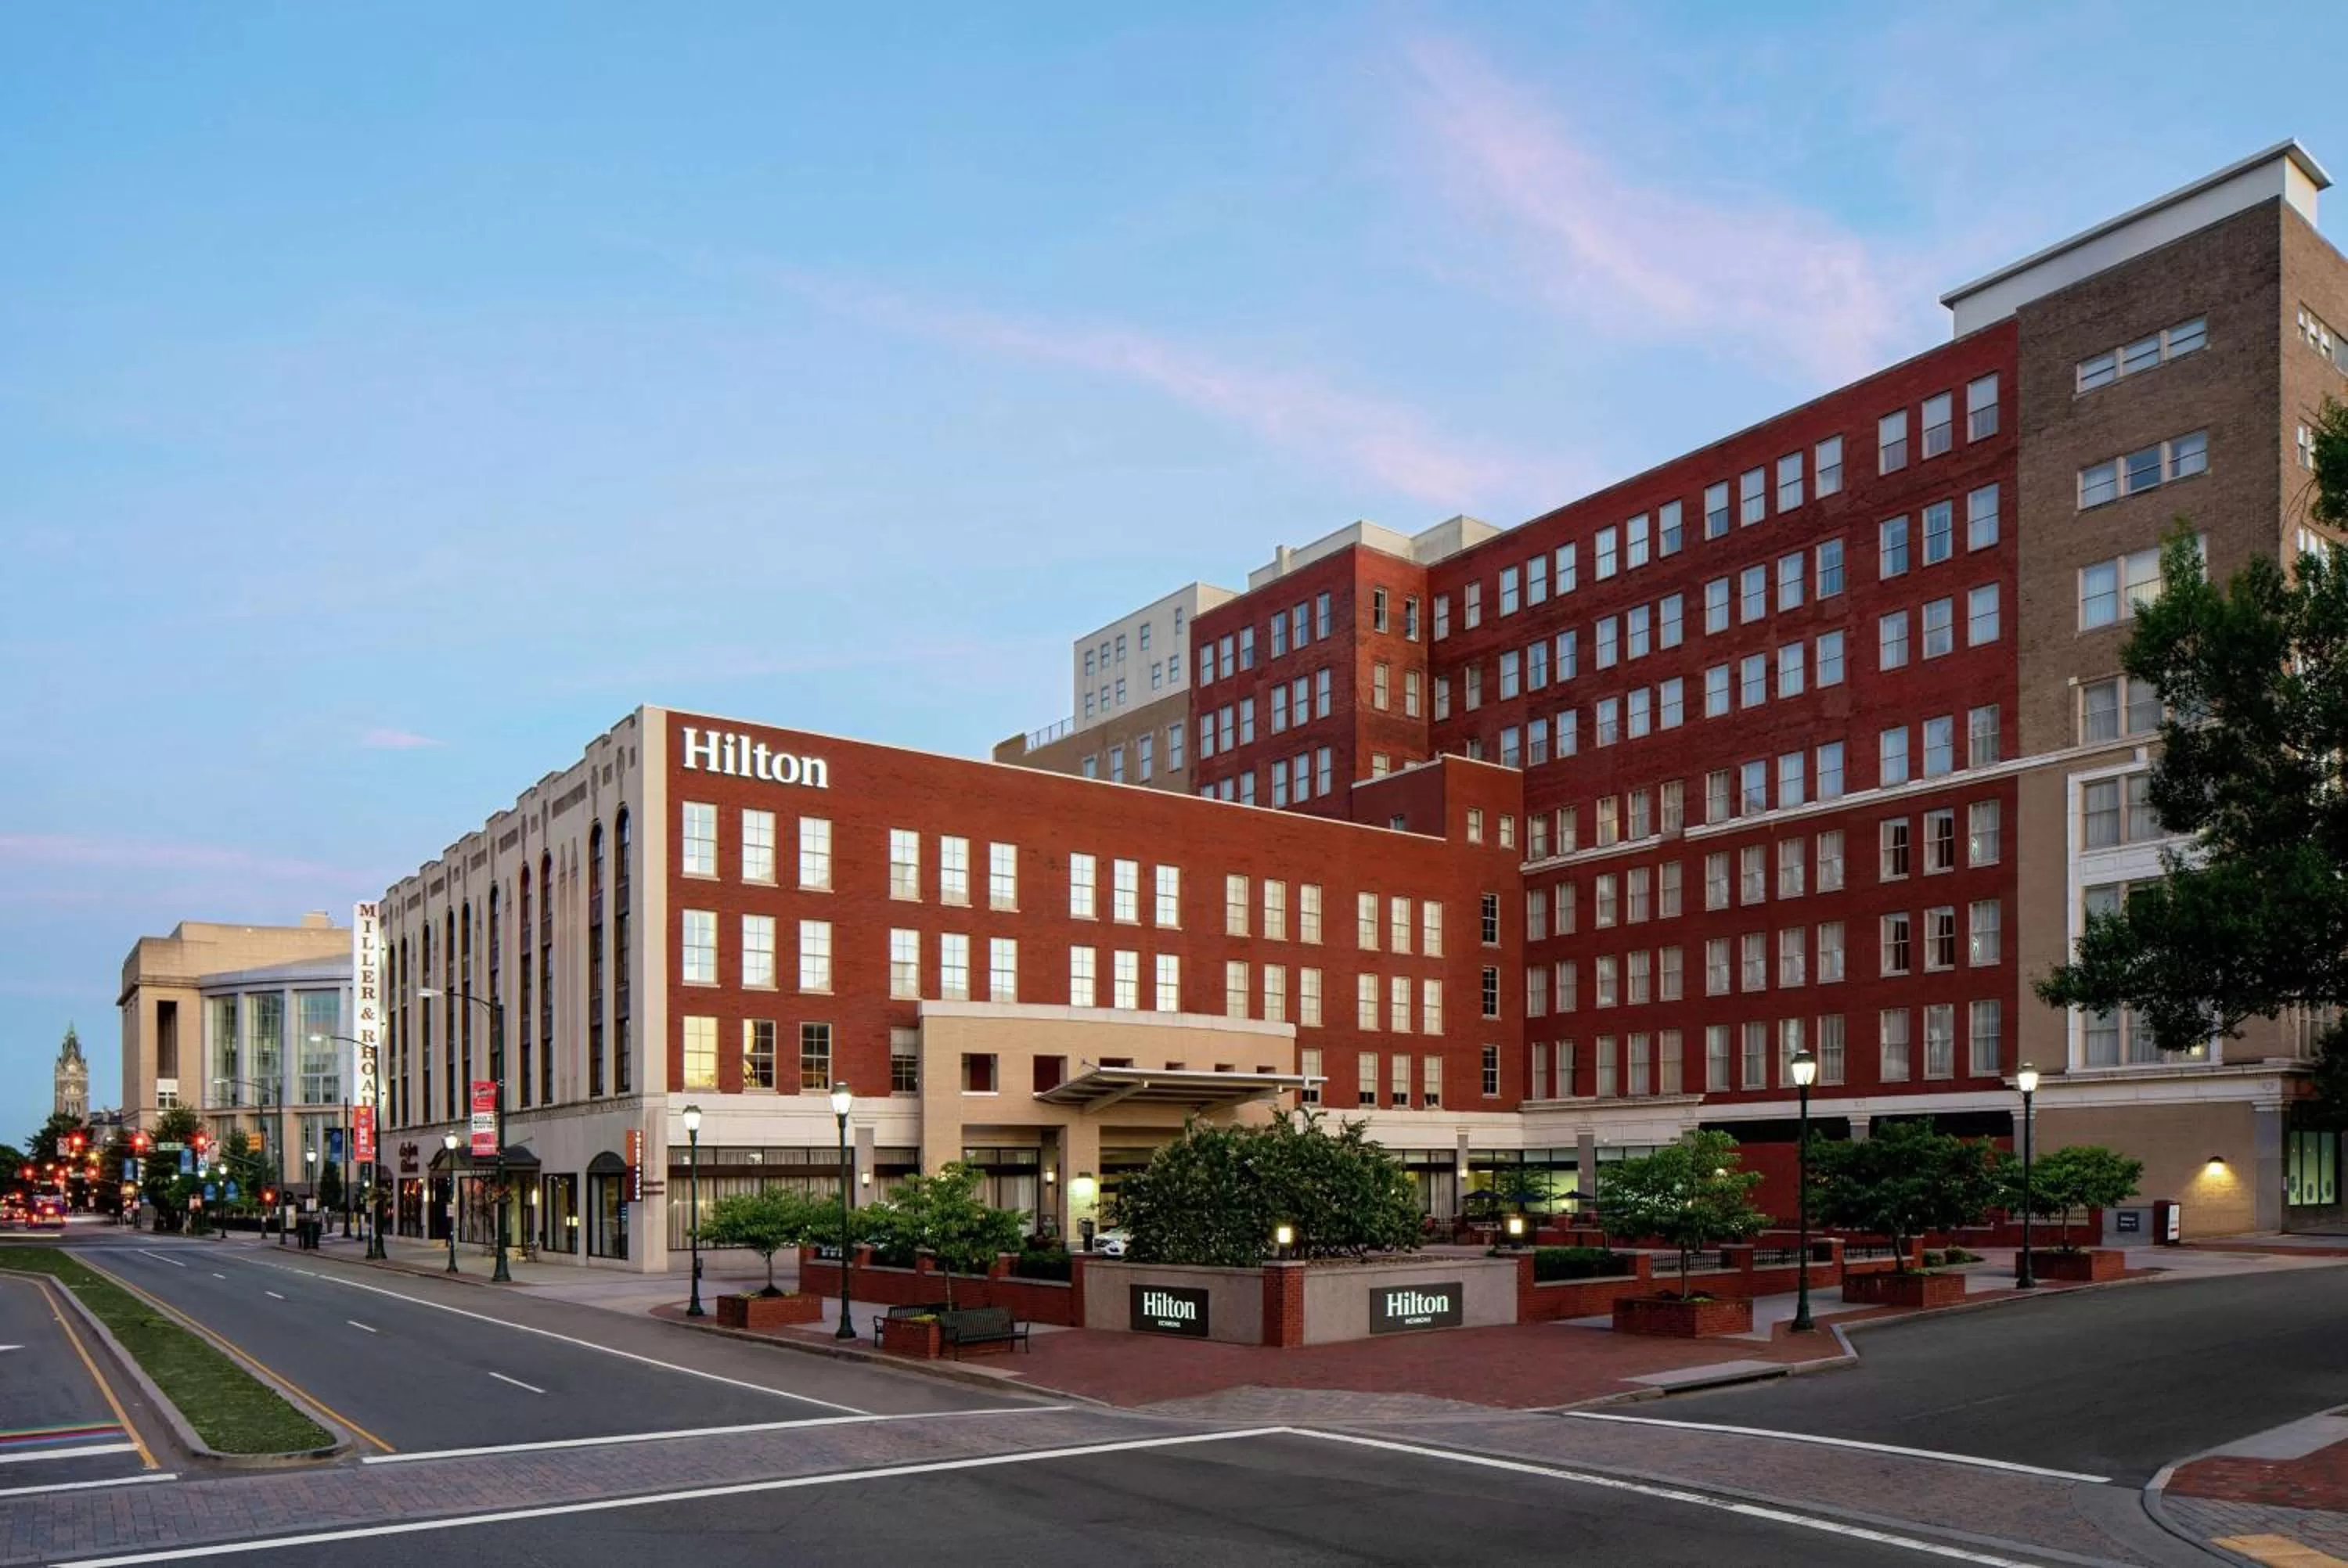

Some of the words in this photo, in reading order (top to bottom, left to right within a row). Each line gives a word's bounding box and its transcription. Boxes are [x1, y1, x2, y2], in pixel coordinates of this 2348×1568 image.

[683, 726, 829, 789] Hilton
[359, 904, 376, 999] MILLER
[361, 1007, 375, 1020] &
[1143, 1292, 1196, 1320] Hilton
[1386, 1291, 1449, 1317] Hilton
